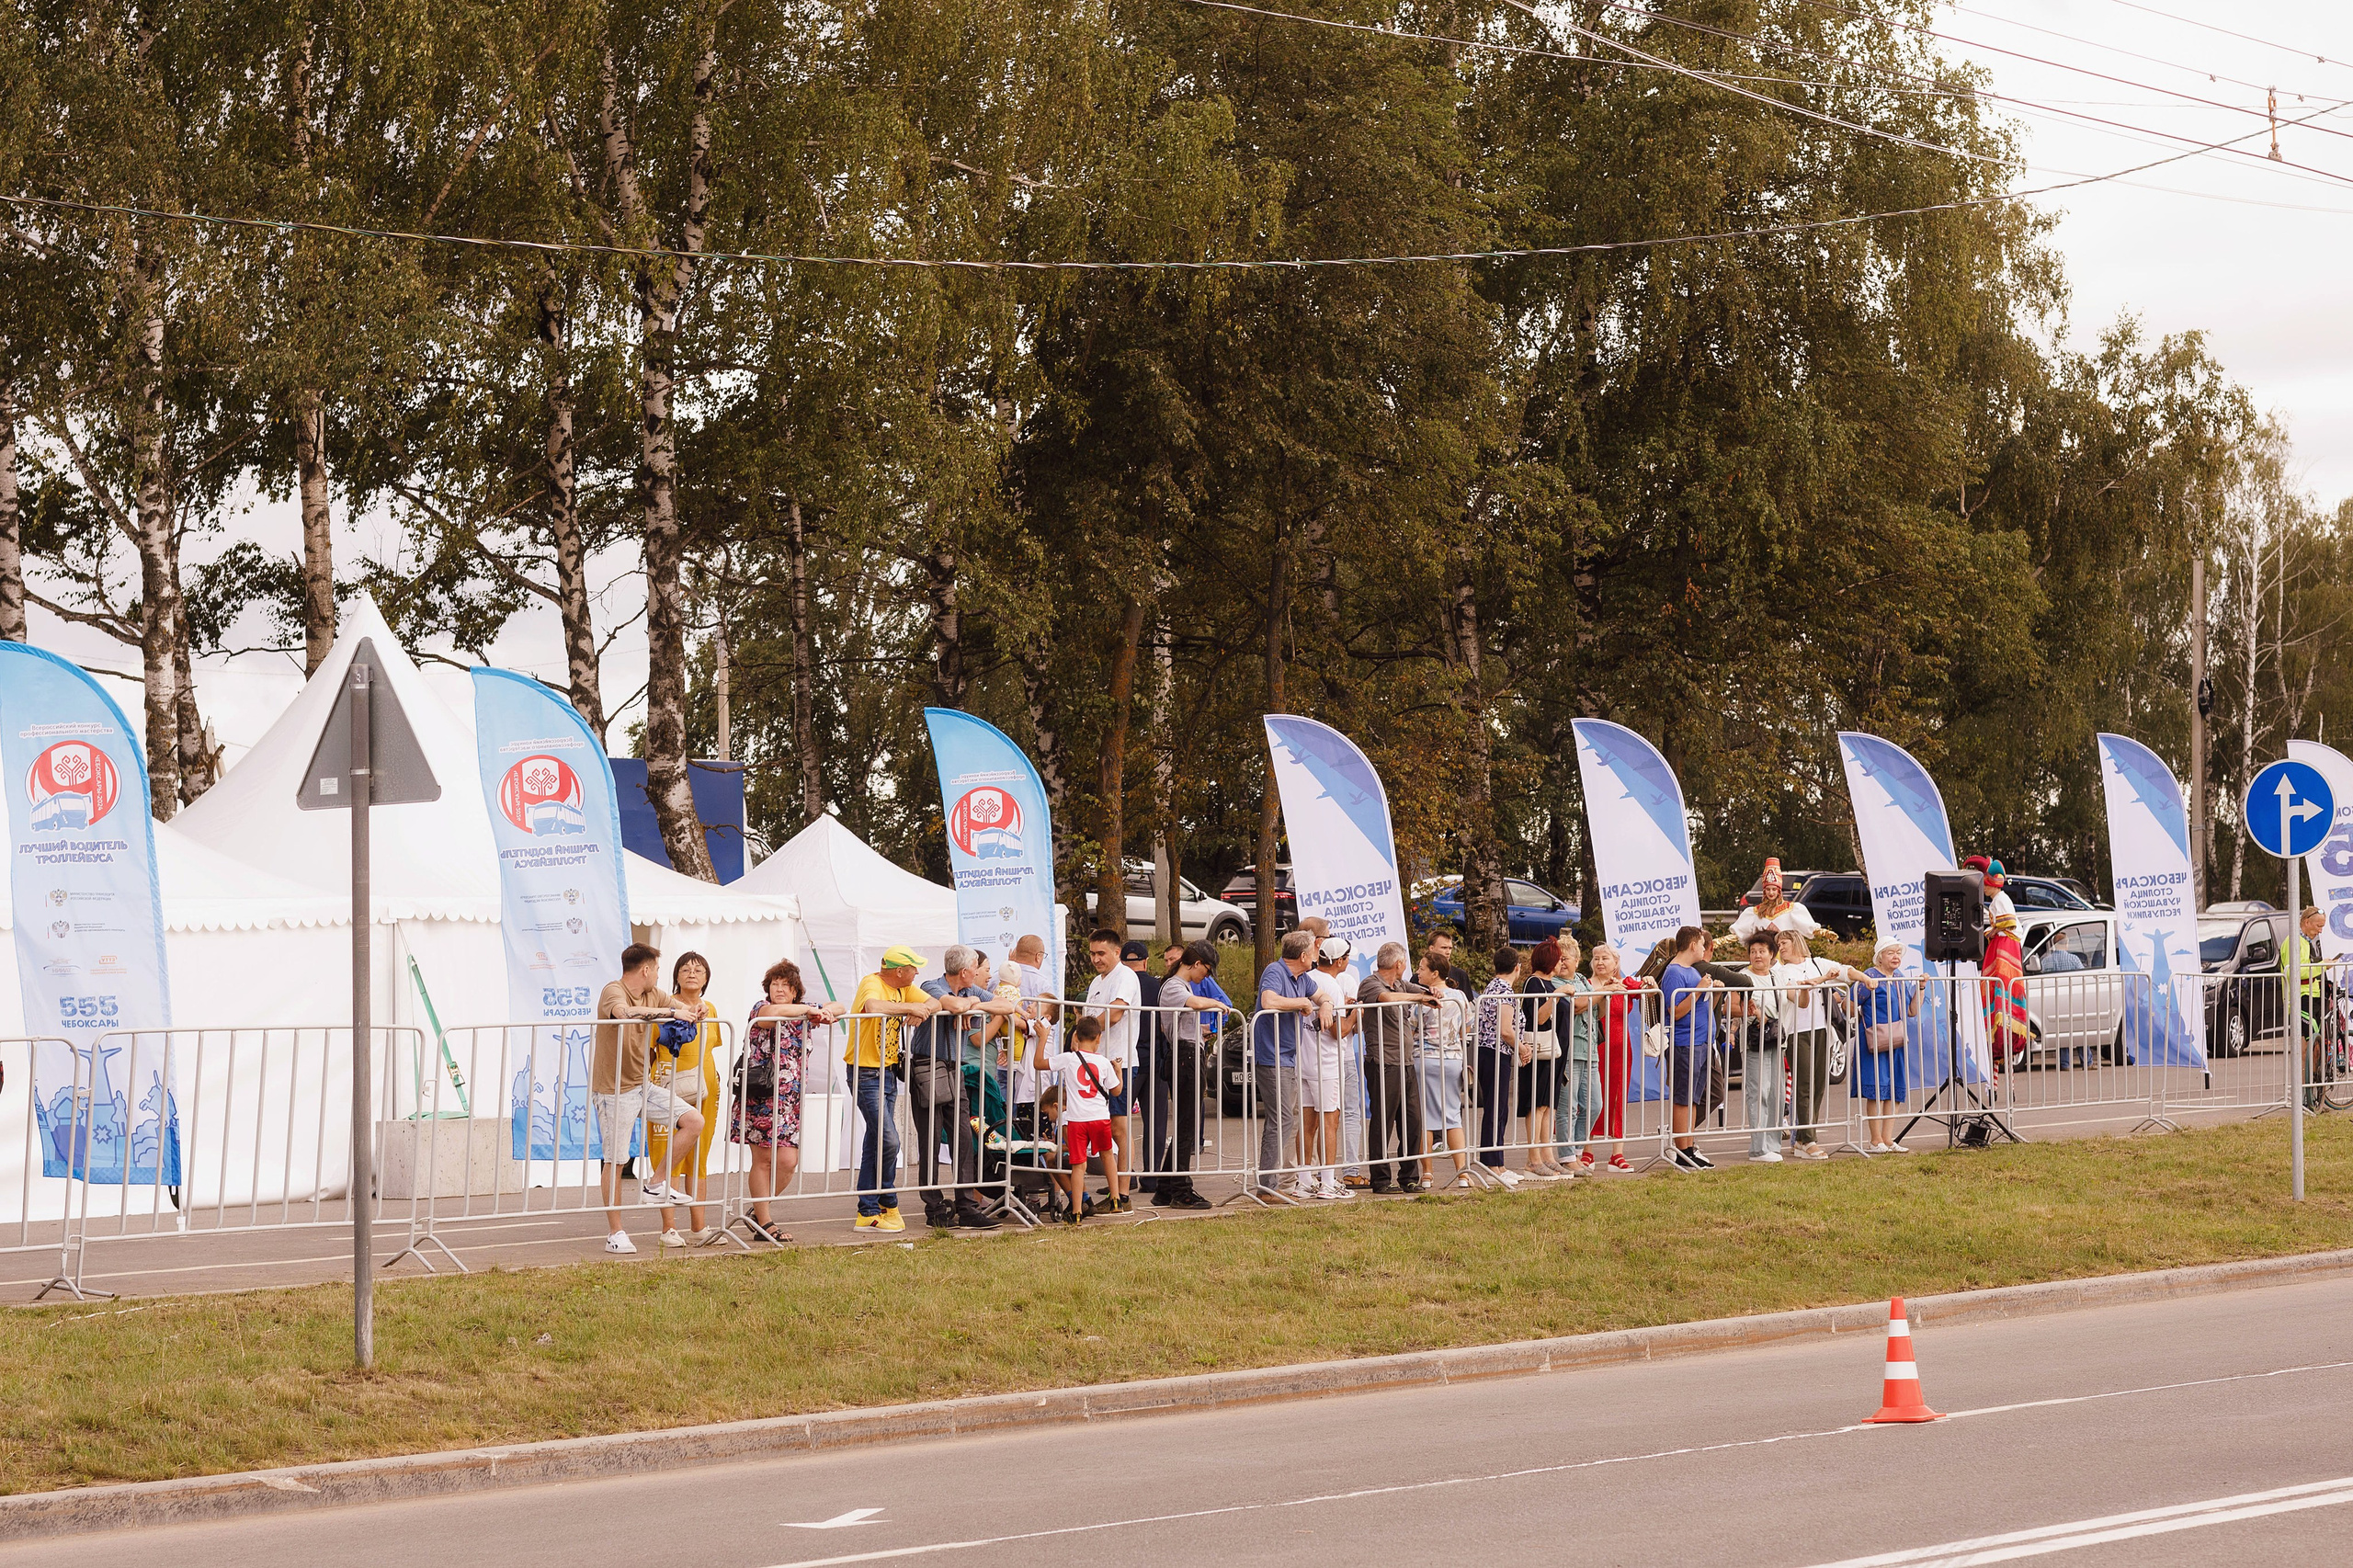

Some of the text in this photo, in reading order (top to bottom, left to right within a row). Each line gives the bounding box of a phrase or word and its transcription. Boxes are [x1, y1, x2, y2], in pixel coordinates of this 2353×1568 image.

[20, 729, 78, 737] профессионального
[96, 755, 104, 811] ЧЕБОКСАРЫ-2024
[19, 840, 128, 854] ЛУЧШИЙ ВОДИТЕЛЬ
[35, 852, 114, 864] ТРОЛЛЕЙБУСА
[60, 995, 119, 1017] 555
[62, 1019, 119, 1028] ЧЕБОКСАРЫ
[1077, 1062, 1099, 1098] 9
